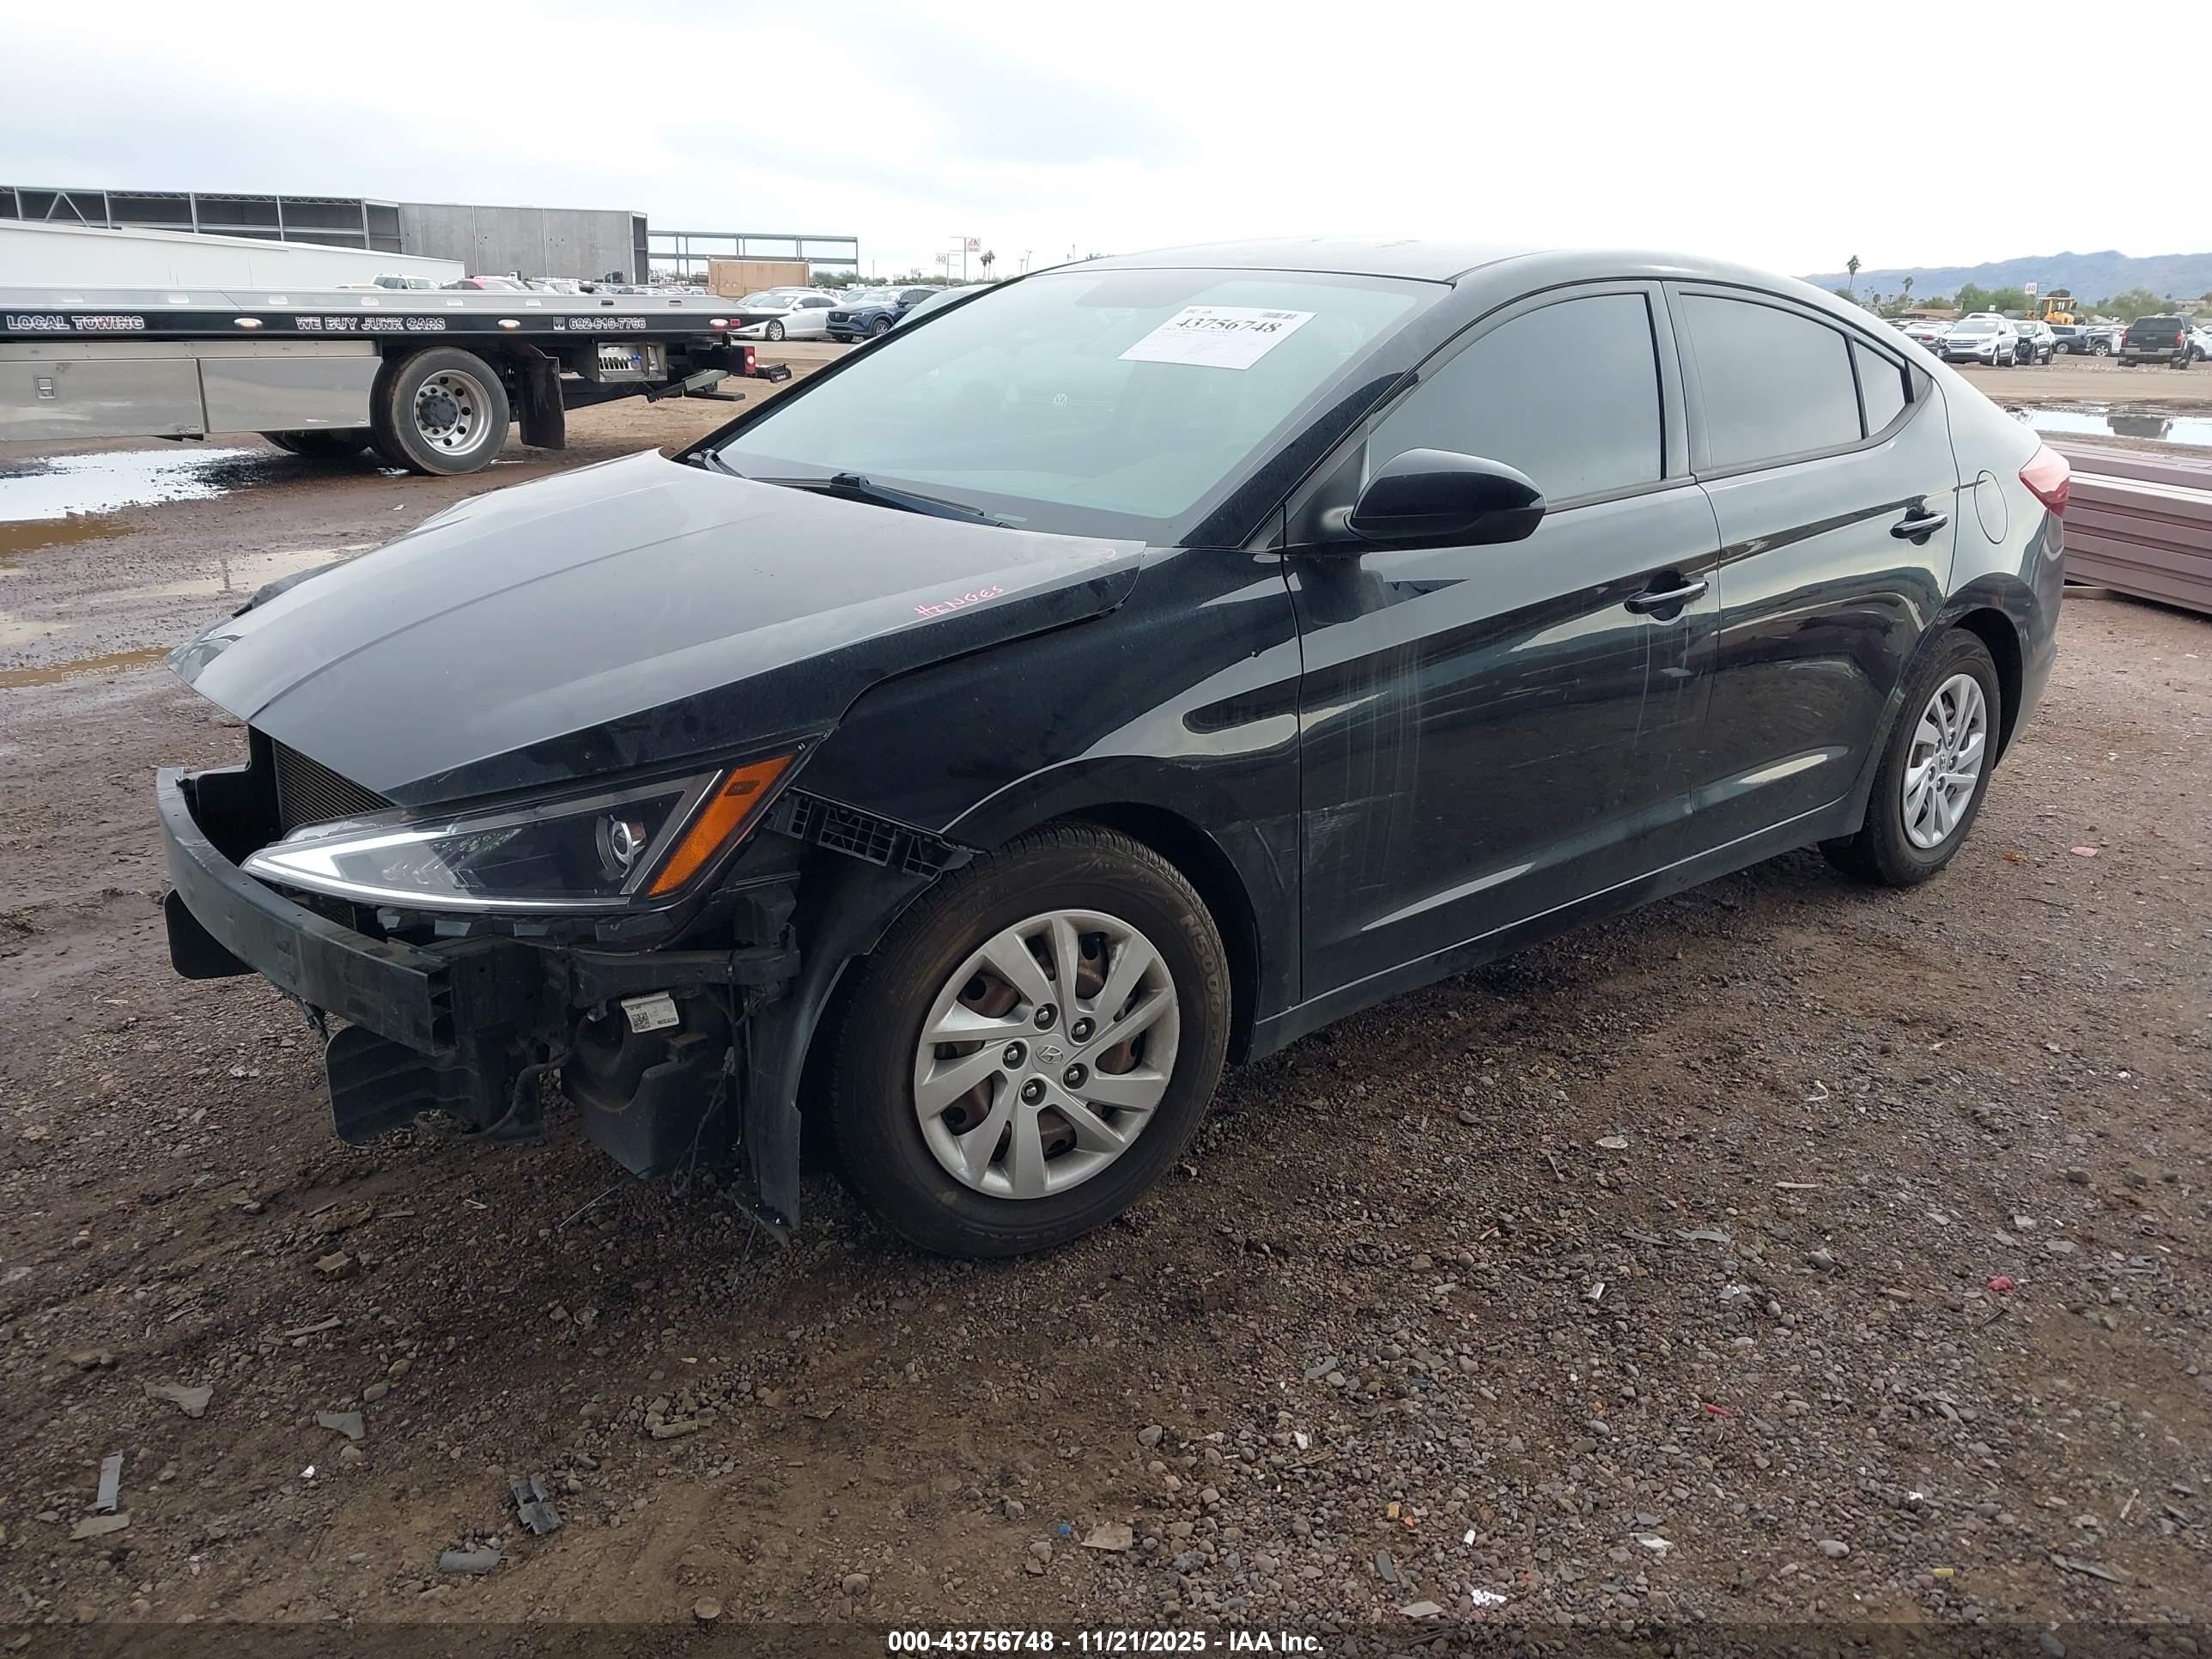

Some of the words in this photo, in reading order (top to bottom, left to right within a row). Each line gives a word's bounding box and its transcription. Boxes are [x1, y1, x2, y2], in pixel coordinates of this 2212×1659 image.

[6, 314, 70, 331] LOCAL
[71, 314, 145, 331] TOWING
[295, 315, 322, 331] WE
[325, 316, 358, 331] BUY
[361, 316, 405, 331] JUNK
[406, 317, 447, 331] CARS
[1176, 317, 1283, 334] 43756748
